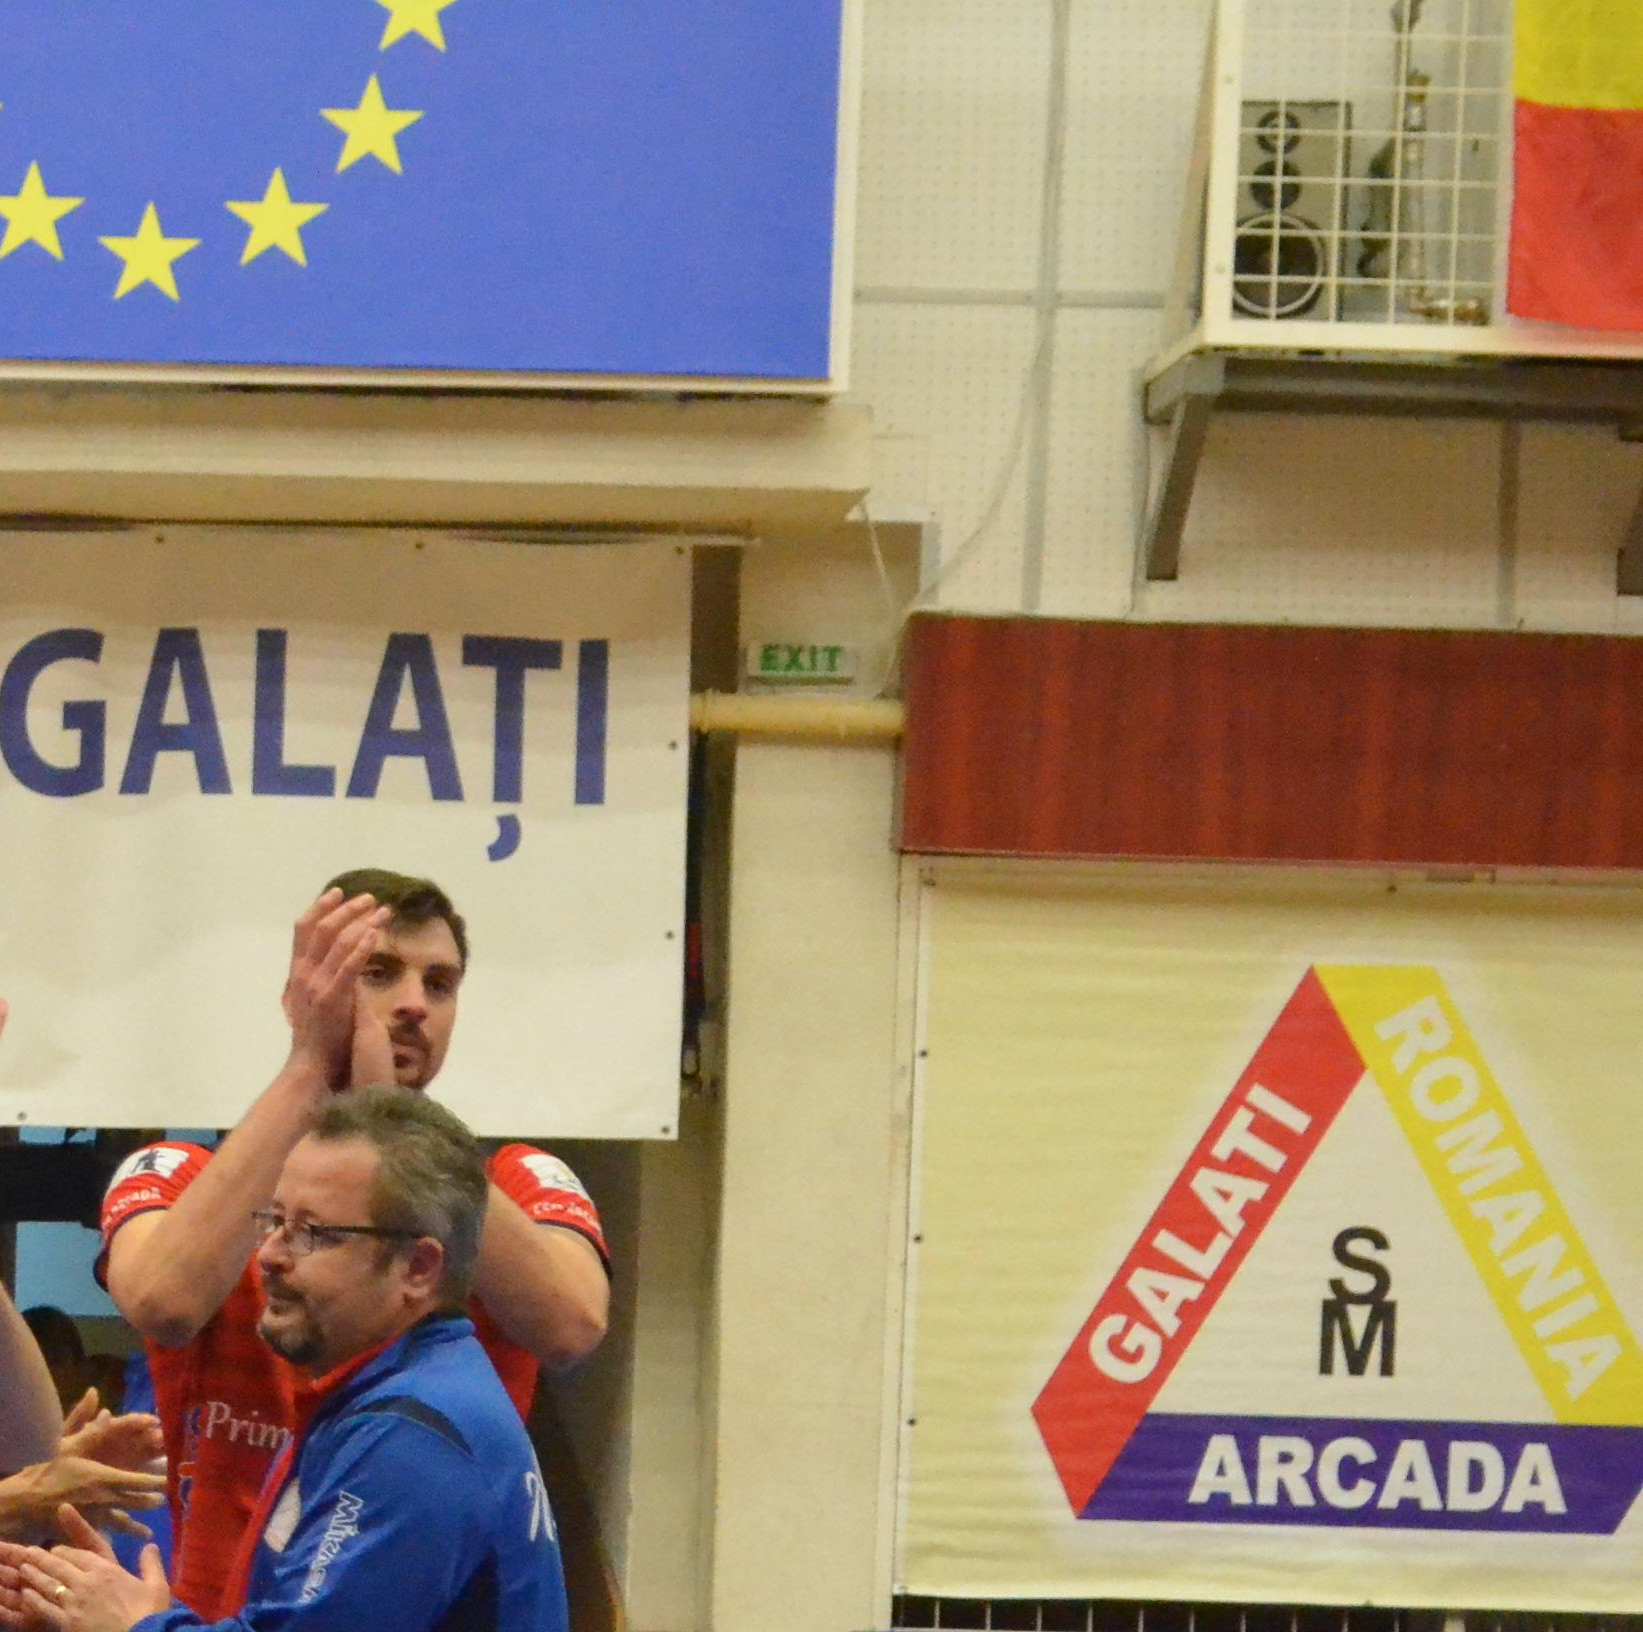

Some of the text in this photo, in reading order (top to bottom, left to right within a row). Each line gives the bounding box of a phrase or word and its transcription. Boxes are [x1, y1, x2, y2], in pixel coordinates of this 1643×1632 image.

[761, 643, 843, 672] EXIT
[1089, 1082, 1313, 1384] GALATI
[1373, 994, 1623, 1401] ROMANIA
[204, 1400, 294, 1449] Prim
[1186, 1433, 1567, 1515] ARCADA
